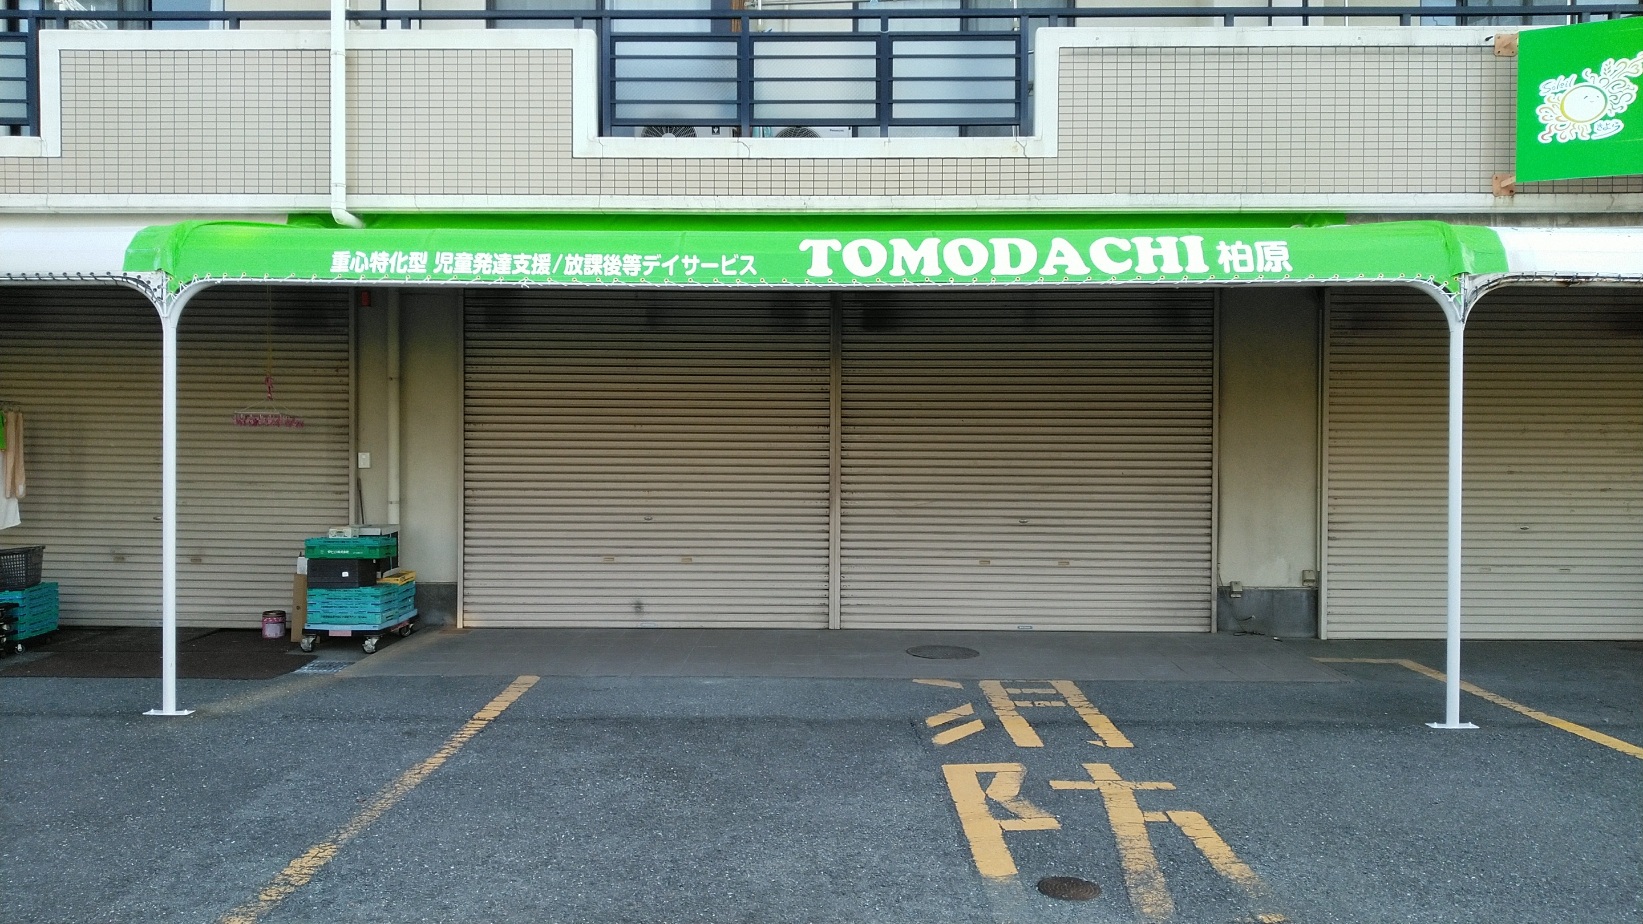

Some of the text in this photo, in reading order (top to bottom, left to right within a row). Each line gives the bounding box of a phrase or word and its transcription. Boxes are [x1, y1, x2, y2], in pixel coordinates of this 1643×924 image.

[1542, 75, 1575, 94] Soleil
[330, 250, 758, 277] 重心特化型 児童発達支援/放課後等デイサービス
[798, 235, 1294, 278] TOMODACHI 柏原
